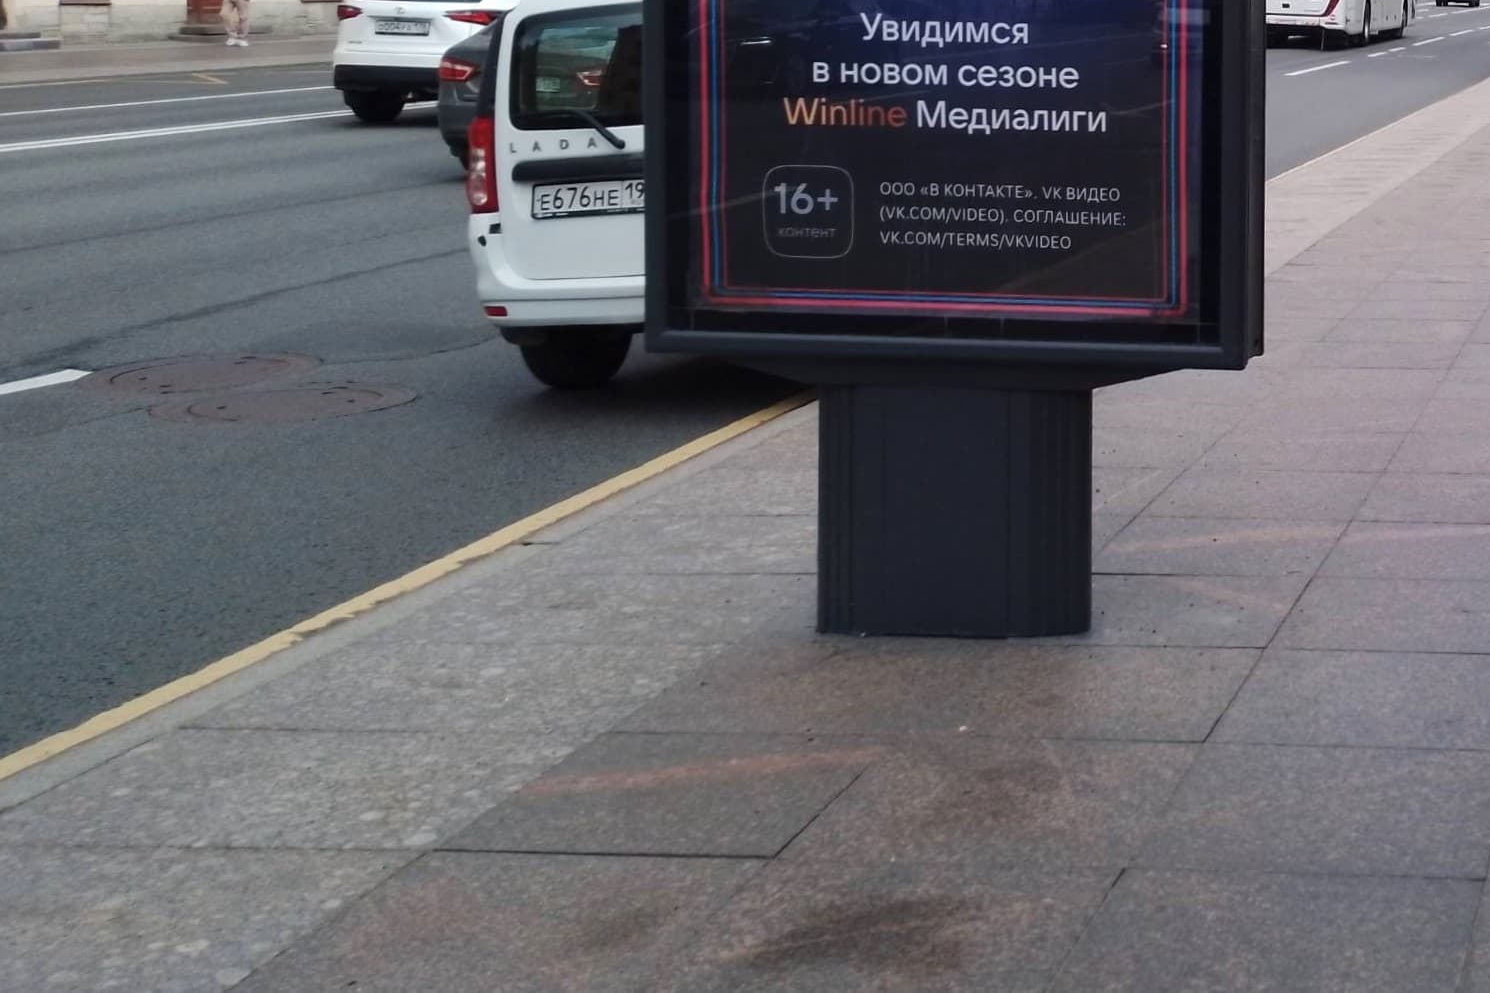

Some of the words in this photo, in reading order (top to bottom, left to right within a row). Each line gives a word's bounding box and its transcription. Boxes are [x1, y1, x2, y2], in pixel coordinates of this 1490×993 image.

[859, 12, 1029, 48] Увидимся
[812, 62, 830, 83] в
[840, 62, 948, 86] новом
[957, 65, 1080, 89] сезоне
[783, 97, 907, 128] Winline
[917, 100, 1107, 134] Медиалиги
[509, 137, 598, 154] LADA
[774, 182, 839, 215] 16+
[880, 181, 916, 197] ООО
[920, 183, 940, 197] «В
[1042, 186, 1062, 200] VK
[1065, 186, 1121, 203] ВИДЕО
[1013, 209, 1127, 226] СОГЛАШЕНИЕ:
[777, 227, 838, 239] контент
[879, 230, 1073, 251] VK.COM/TERMS/VKVIDEO
